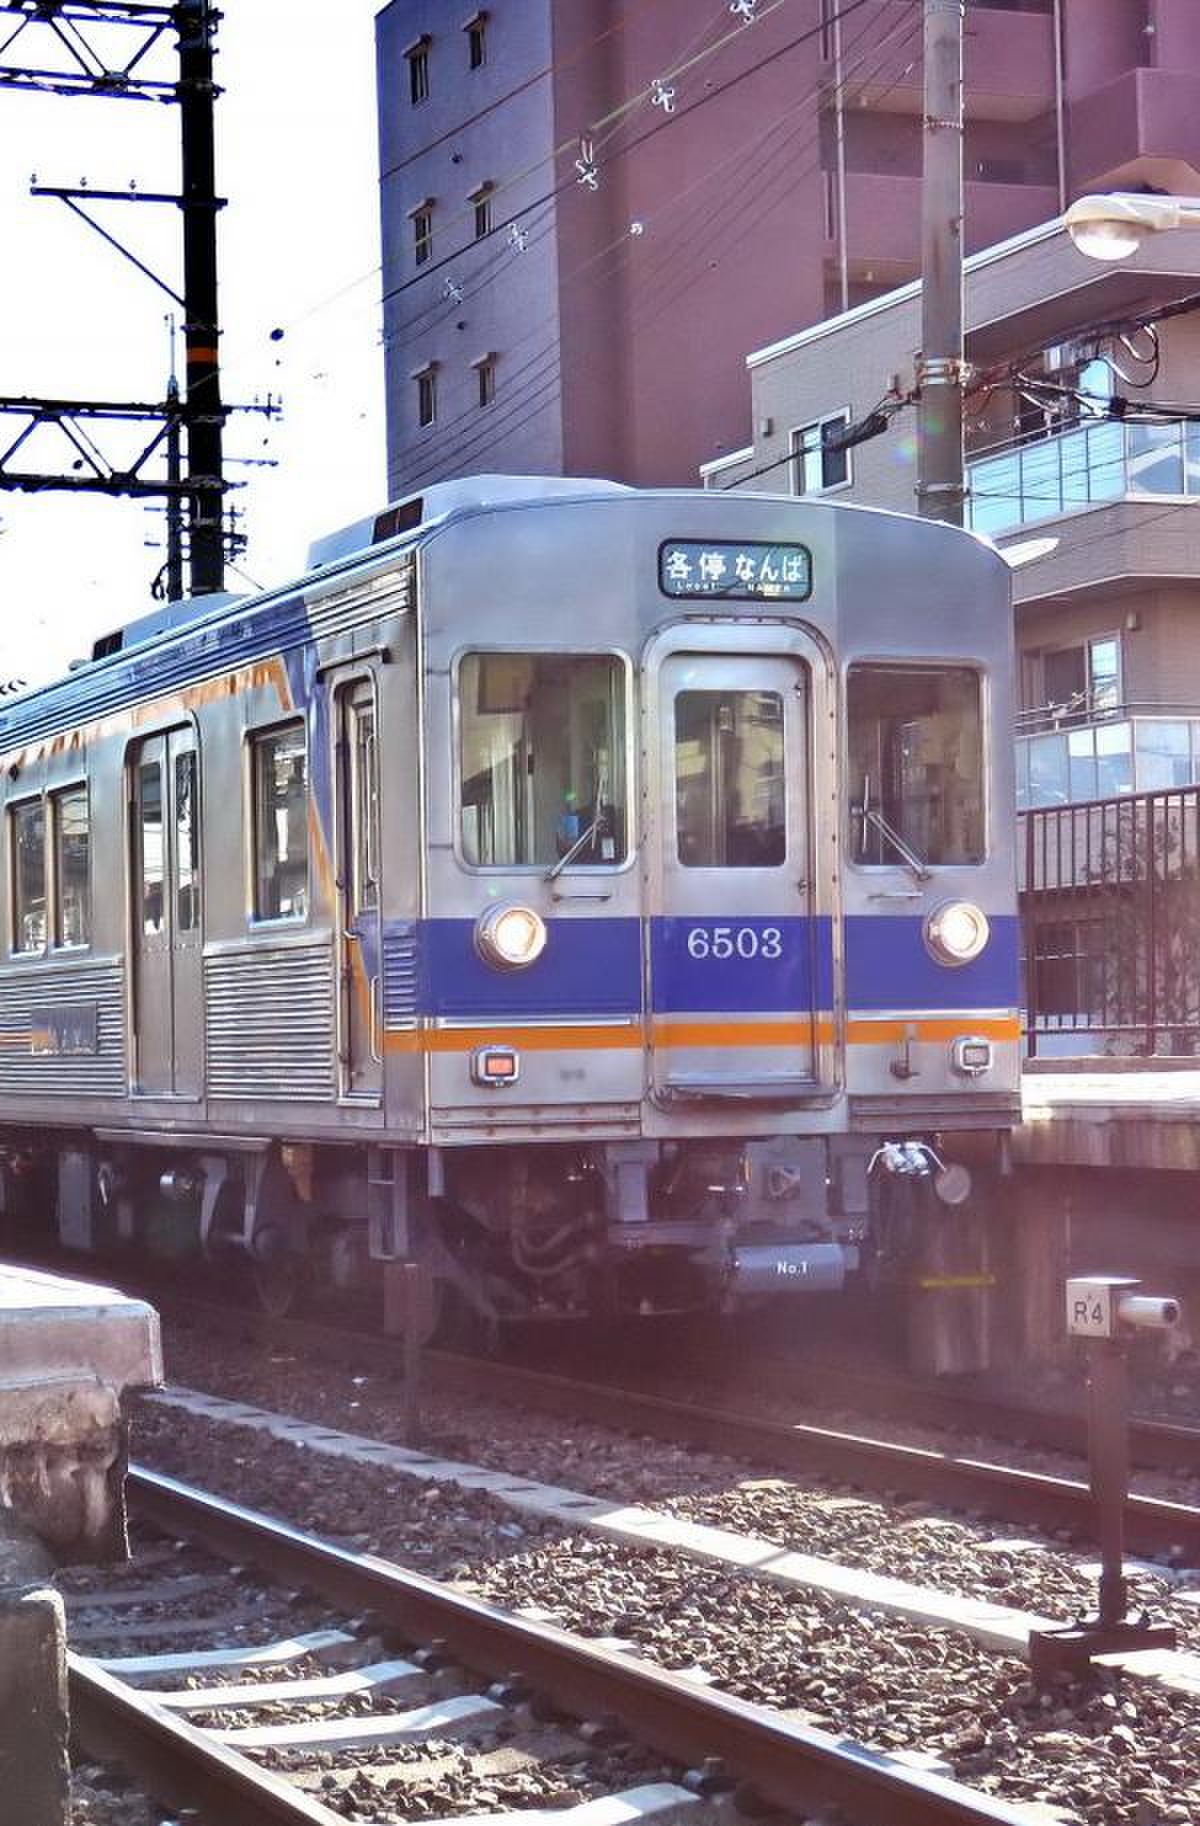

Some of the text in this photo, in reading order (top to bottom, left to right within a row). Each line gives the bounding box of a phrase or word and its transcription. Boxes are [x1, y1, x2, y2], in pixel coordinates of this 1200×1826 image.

[735, 553, 803, 582] なんば
[687, 927, 783, 959] 6503
[777, 1260, 809, 1275] No.1
[1073, 1301, 1105, 1325] R4
